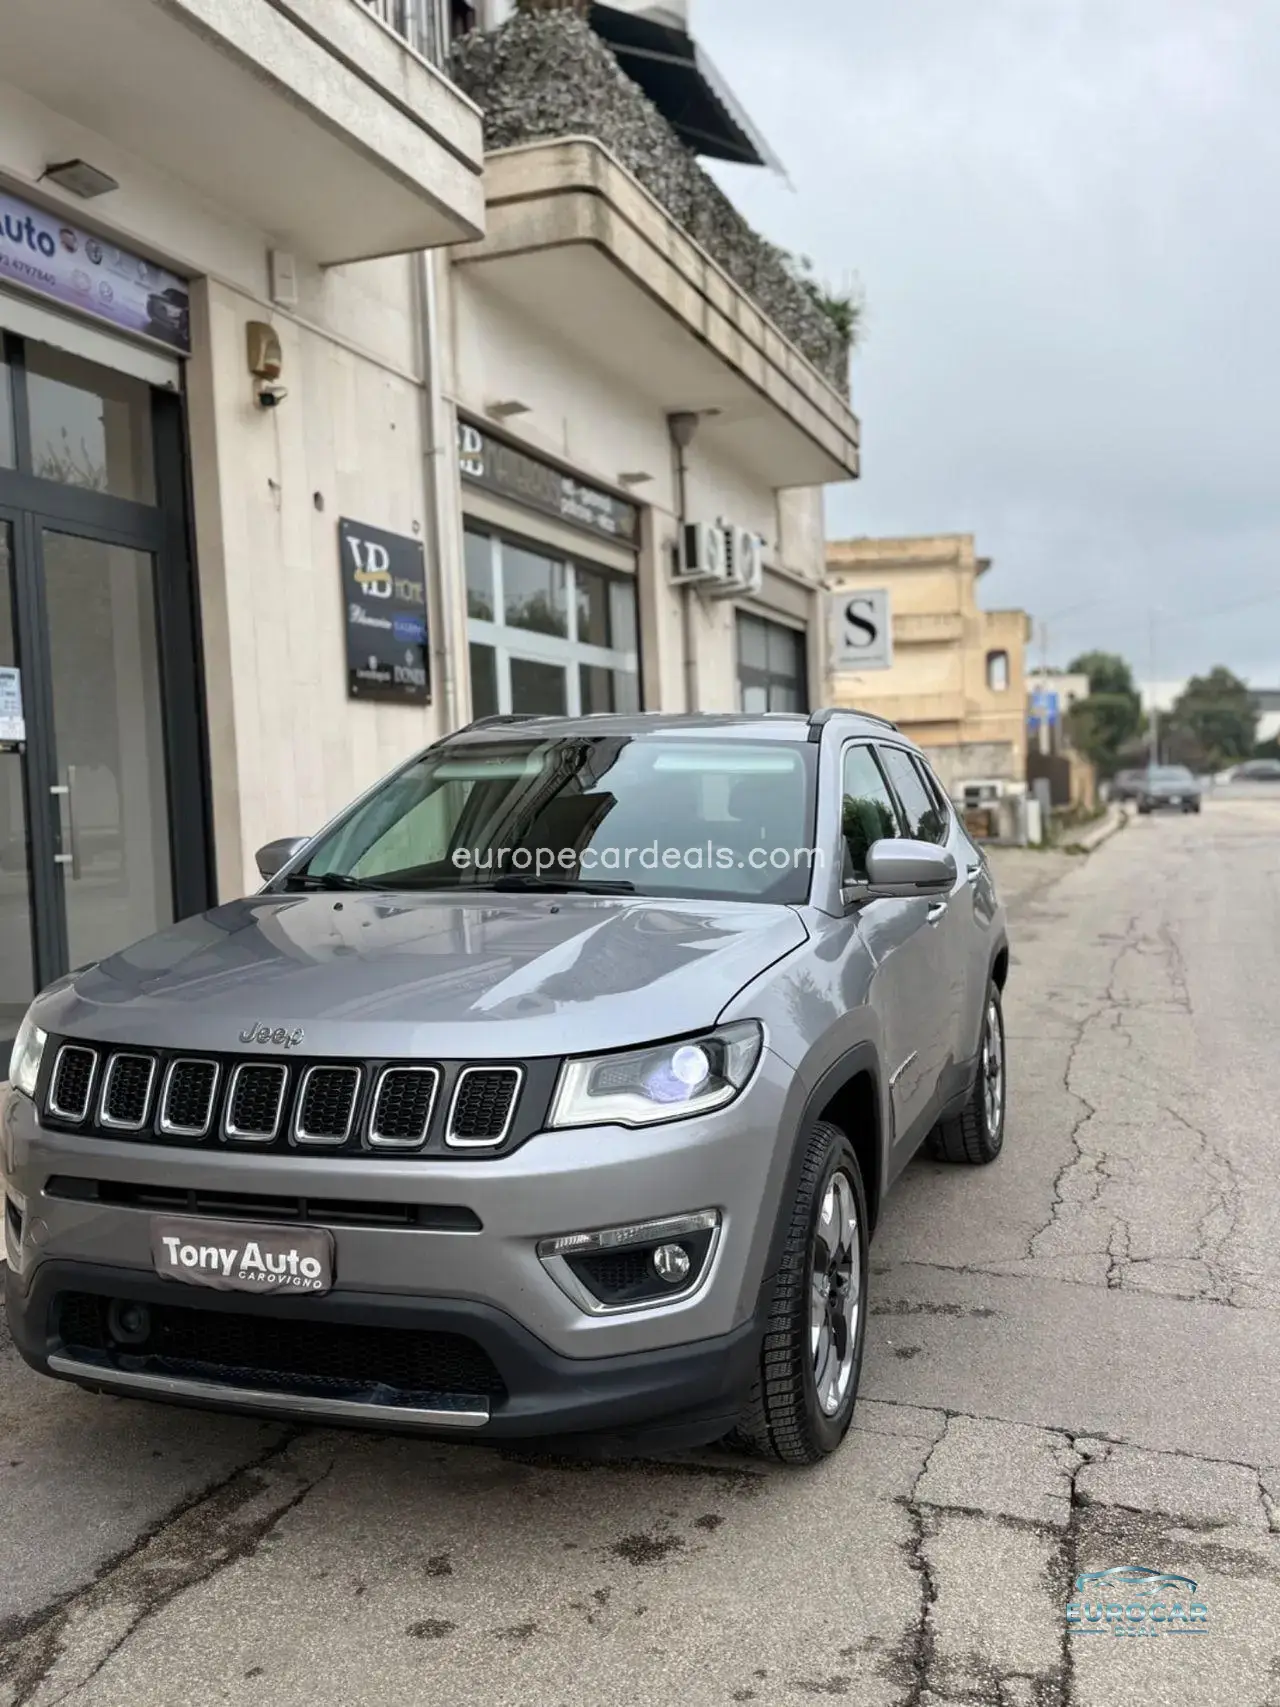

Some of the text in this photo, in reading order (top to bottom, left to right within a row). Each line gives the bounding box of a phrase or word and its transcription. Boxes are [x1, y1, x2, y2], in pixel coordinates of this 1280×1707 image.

[0, 214, 56, 257] uto
[844, 597, 878, 648] S
[239, 1021, 305, 1049] Jeep
[238, 1269, 323, 1290] CAROVIGNO
